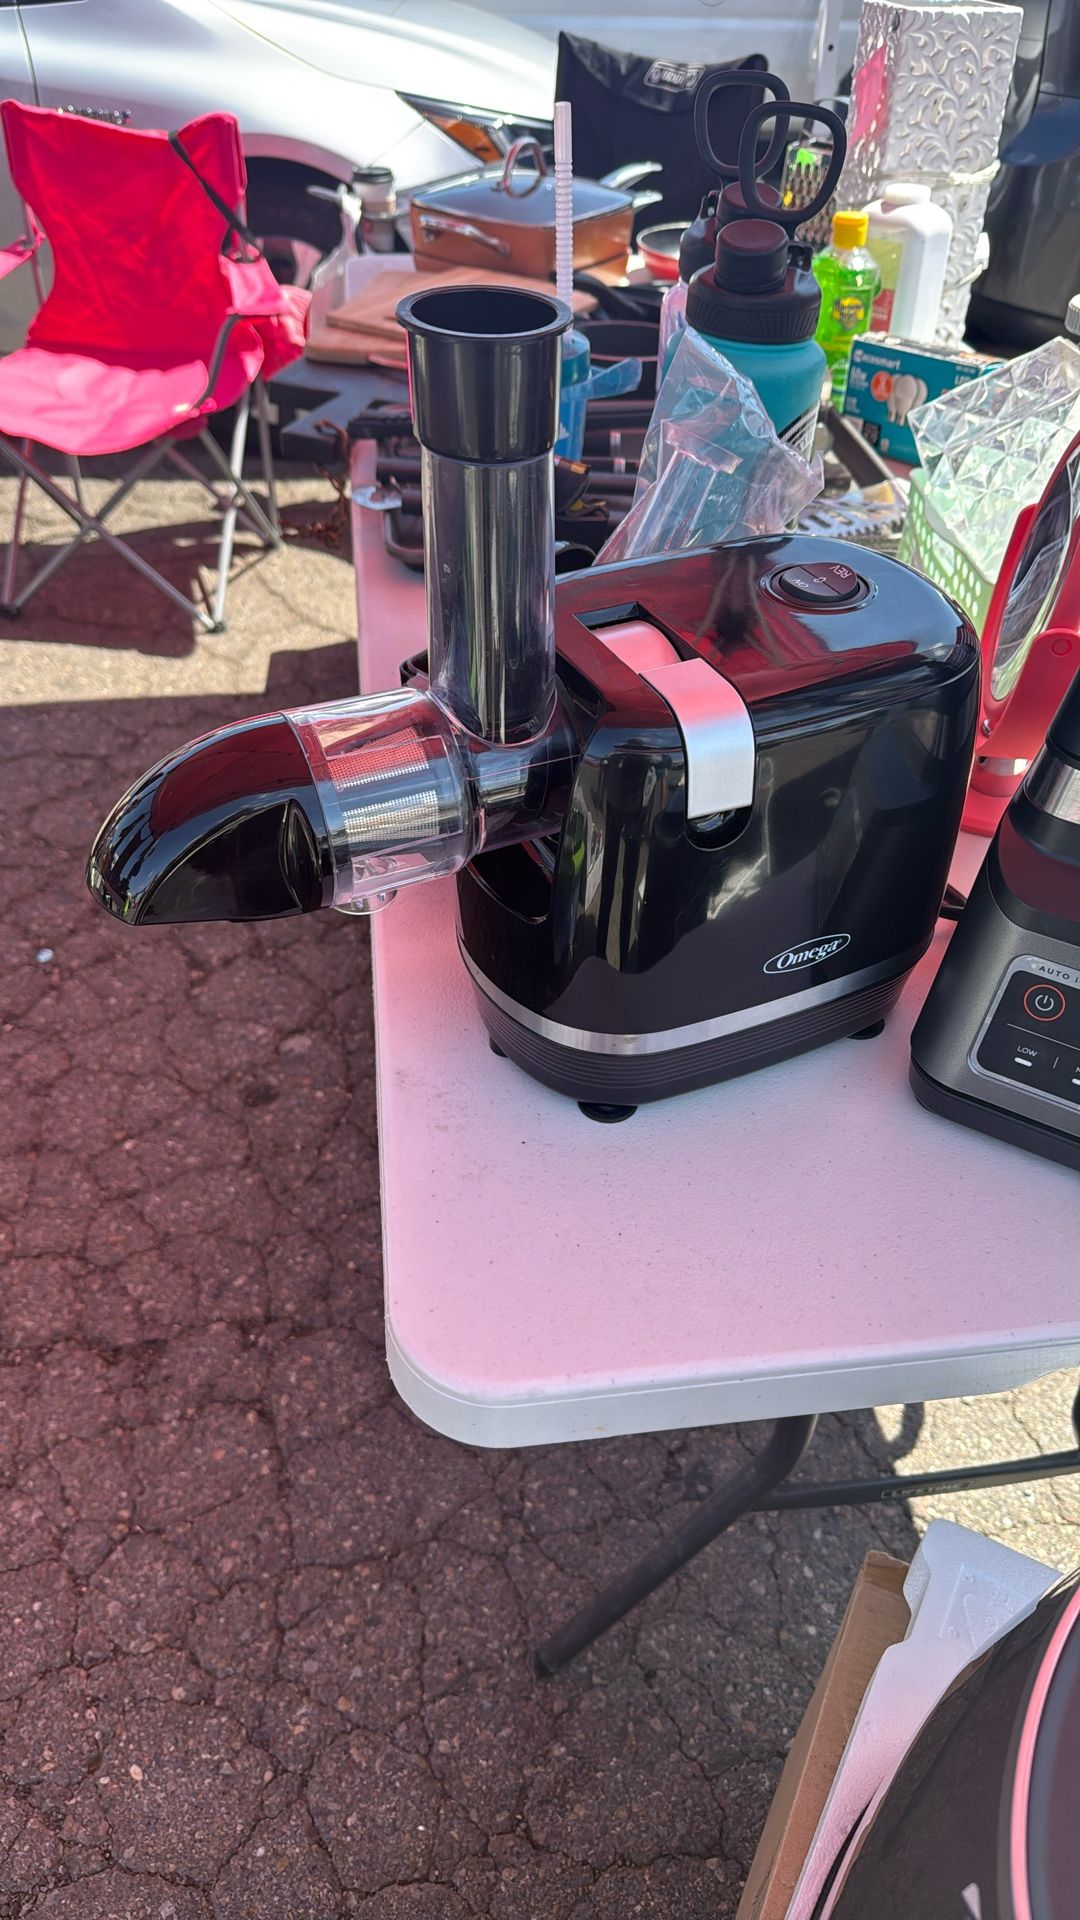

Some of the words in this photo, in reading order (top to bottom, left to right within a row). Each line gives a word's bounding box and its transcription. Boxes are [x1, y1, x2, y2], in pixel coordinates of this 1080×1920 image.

[829, 565, 853, 579] REV
[791, 579, 809, 588] ON
[776, 940, 839, 969] Omega
[1038, 965, 1070, 980] AUTO
[1017, 1045, 1038, 1057] LOW
